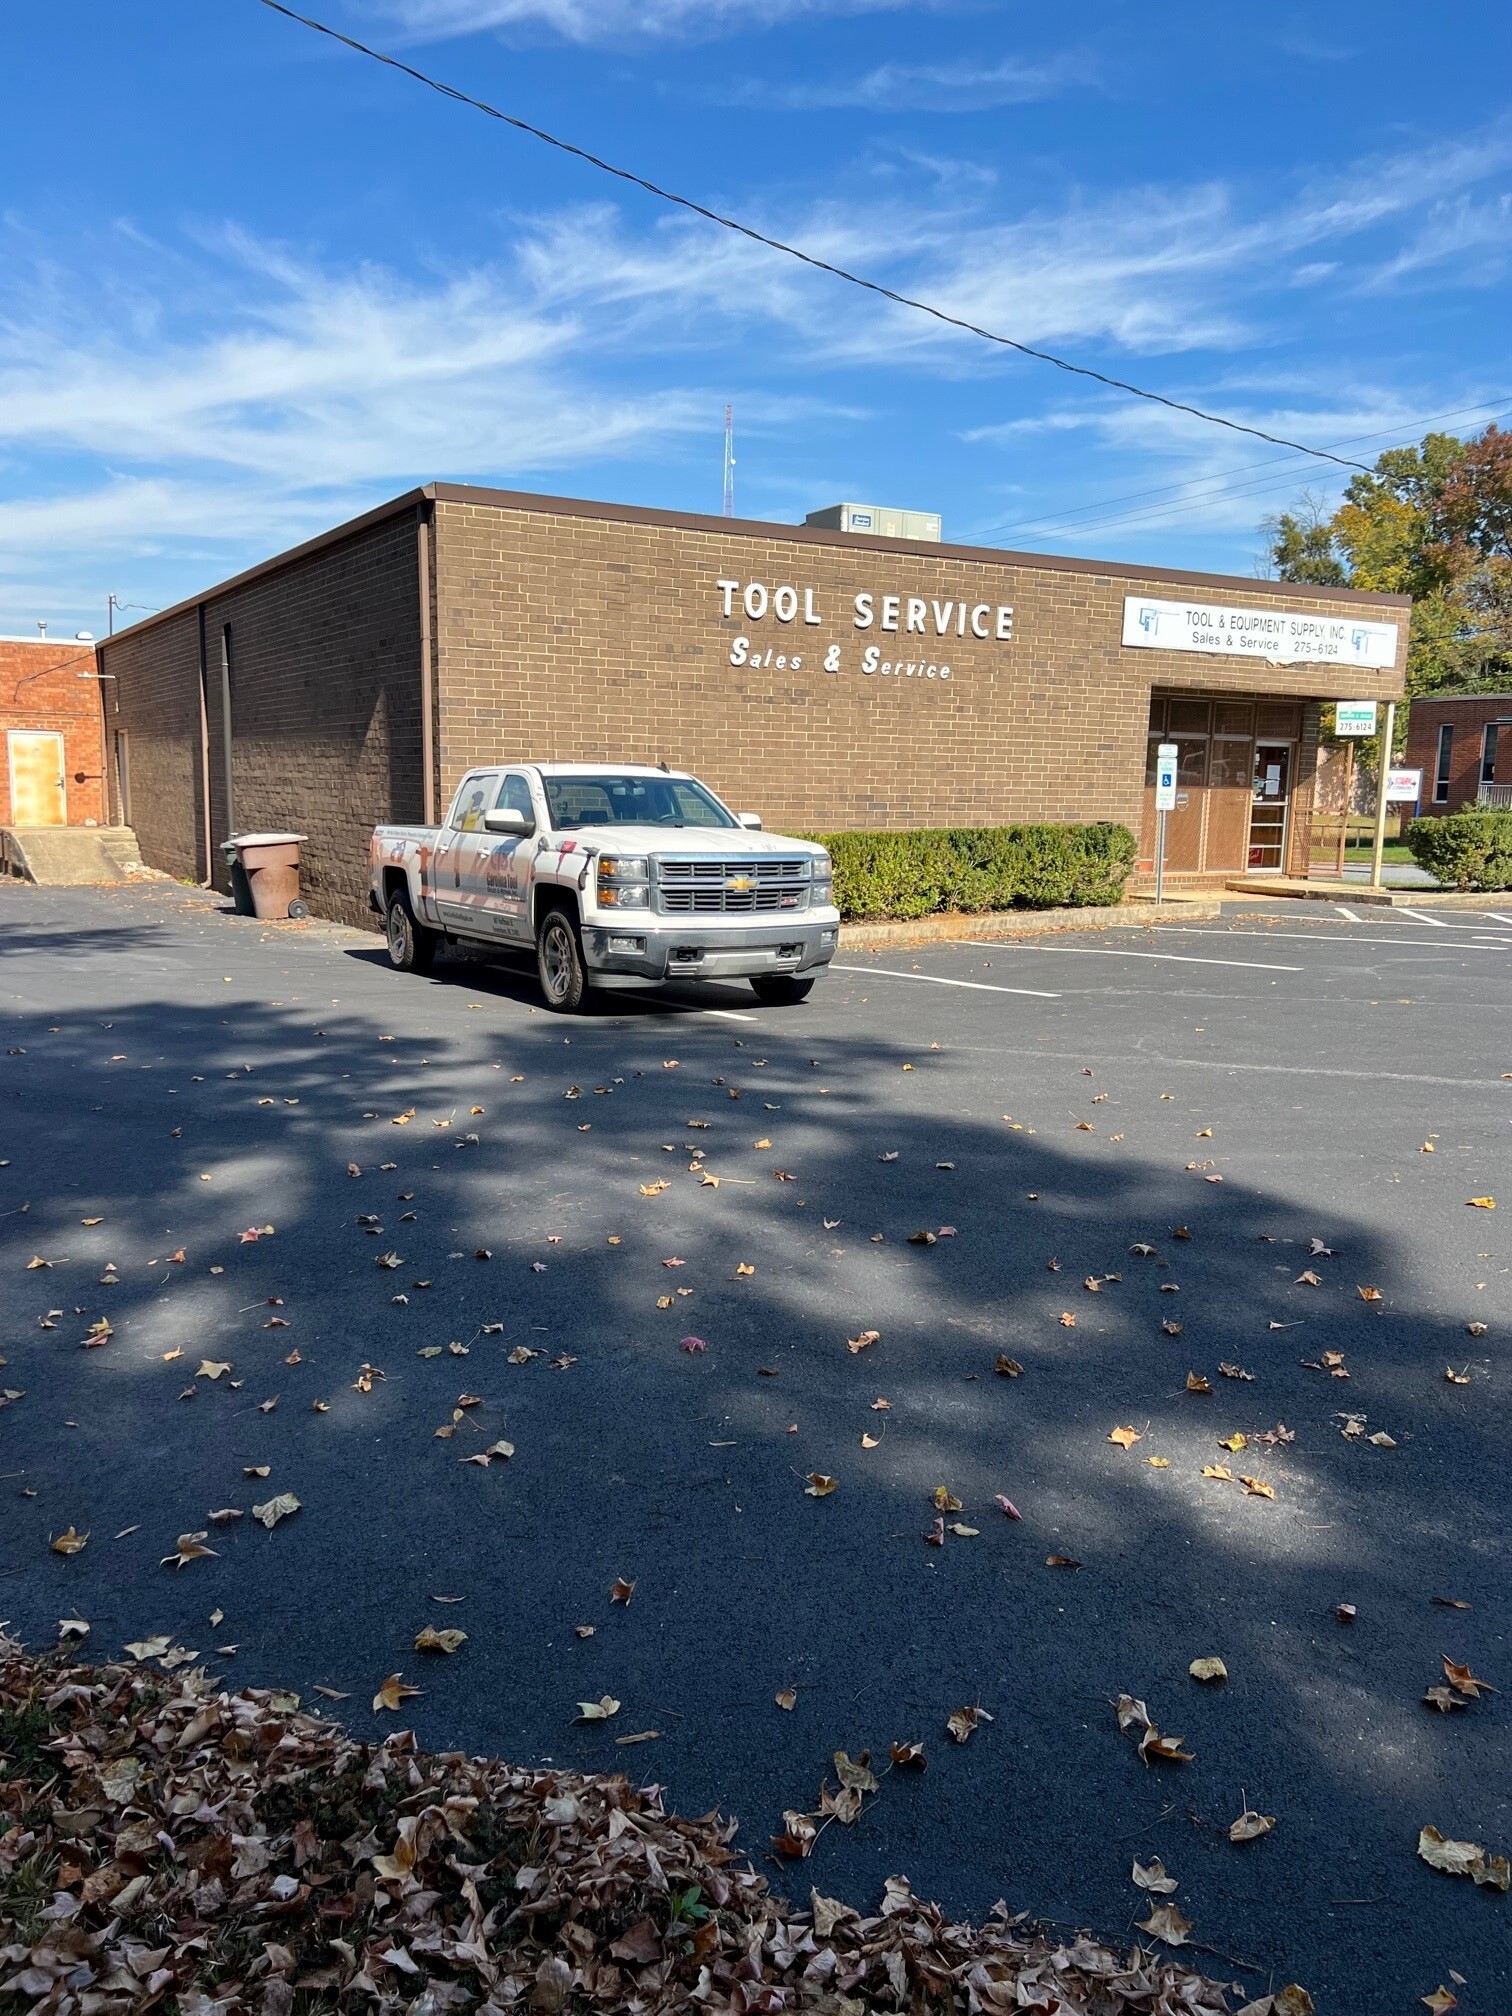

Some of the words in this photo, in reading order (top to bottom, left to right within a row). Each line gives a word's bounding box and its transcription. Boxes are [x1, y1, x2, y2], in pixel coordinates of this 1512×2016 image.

[717, 580, 822, 625] TOOL
[854, 593, 1014, 641] SERVICE
[1186, 611, 1213, 627] TOOL
[1219, 615, 1225, 628] &
[1230, 616, 1286, 633] EQUIPMENT
[1192, 631, 1220, 646] Sales
[1226, 635, 1233, 646] &
[1239, 635, 1279, 650] Service
[1294, 641, 1338, 655] 275-6124
[729, 636, 803, 670] Sales
[823, 645, 842, 673] &
[862, 646, 951, 680] Service
[1340, 722, 1372, 731] 275-6124
